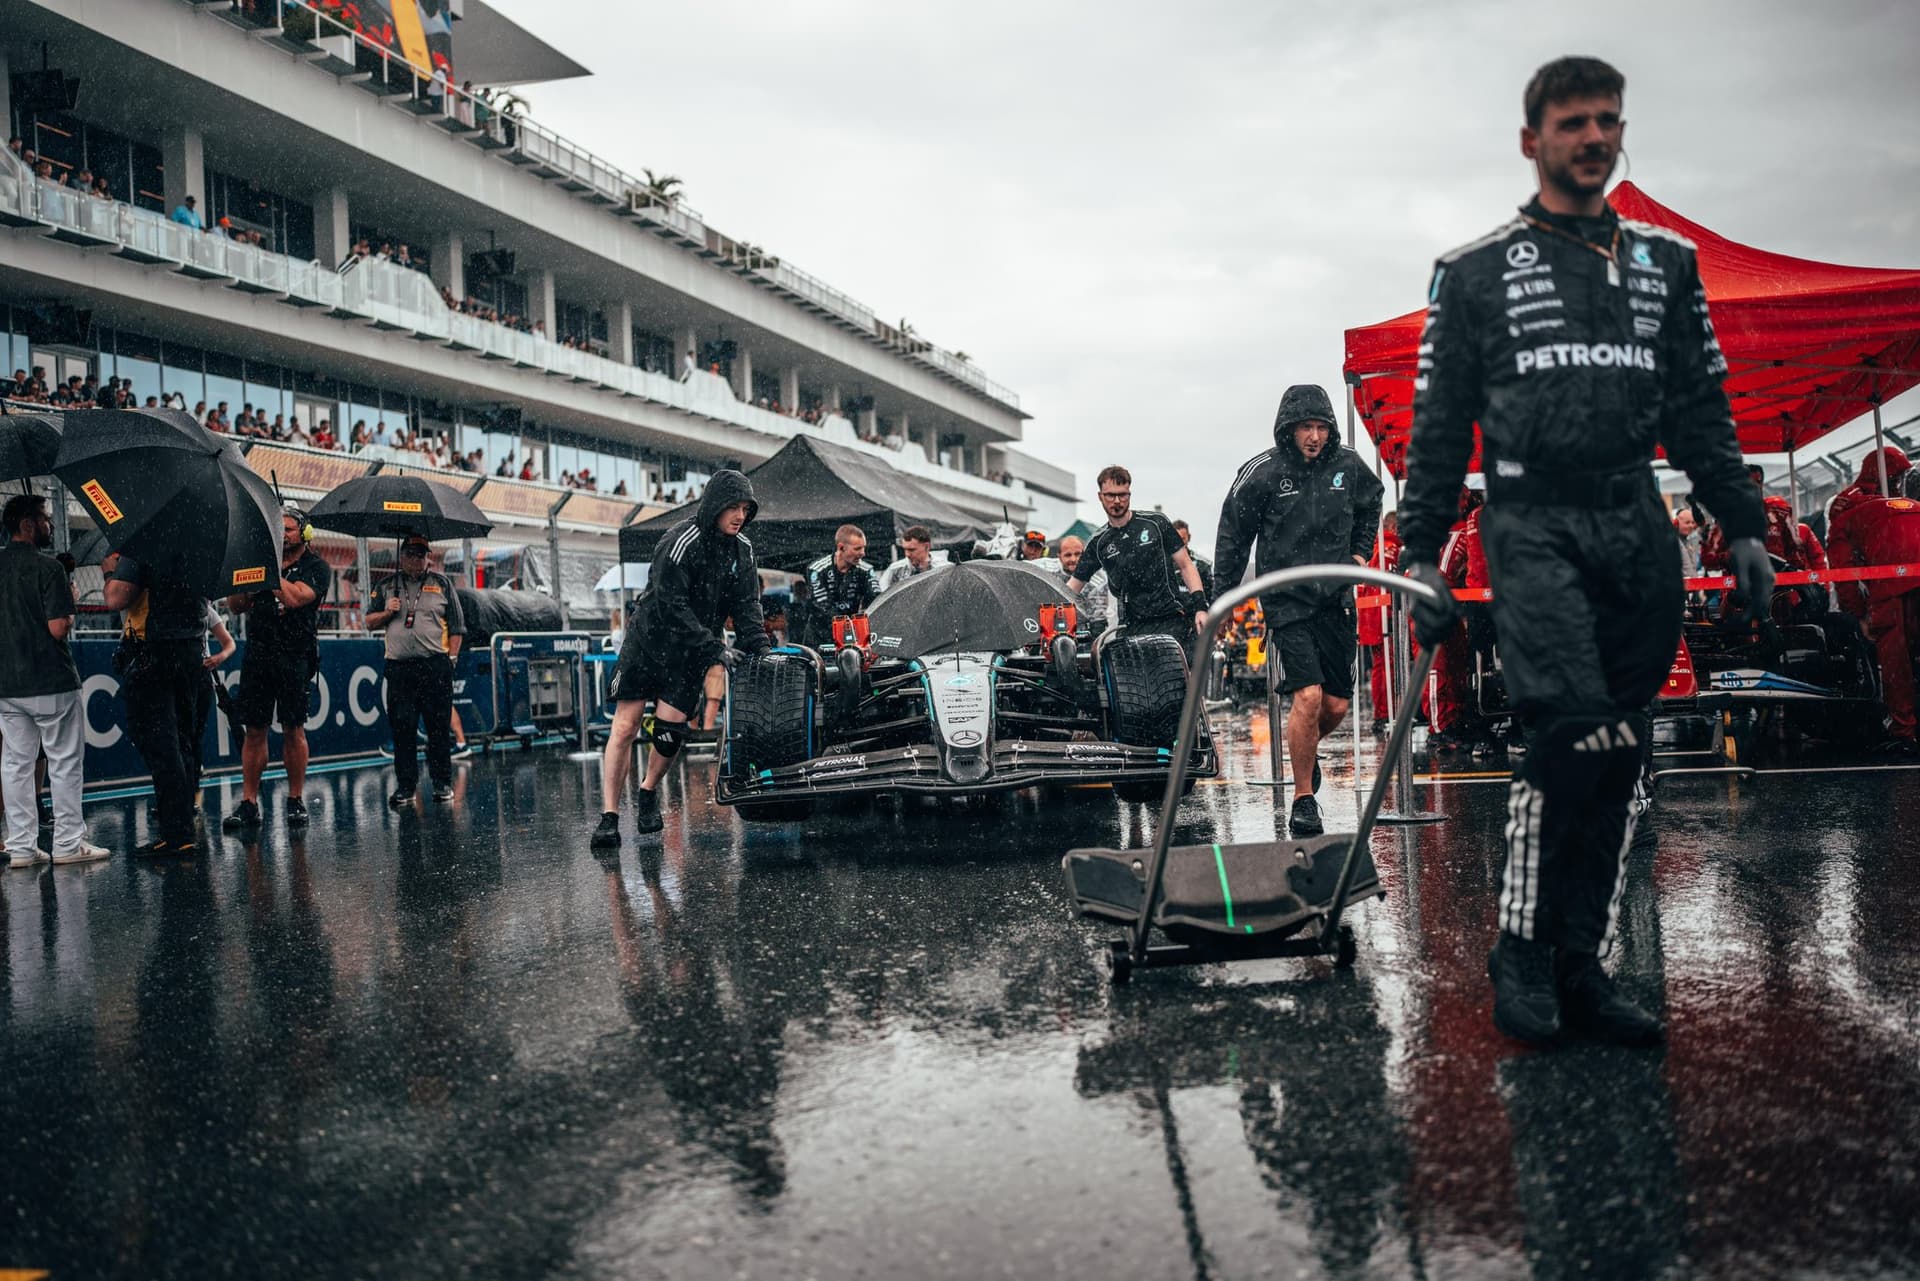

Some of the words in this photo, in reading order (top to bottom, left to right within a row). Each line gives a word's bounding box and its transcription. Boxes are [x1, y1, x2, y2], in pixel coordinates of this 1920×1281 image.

[1524, 278, 1556, 296] UBS
[1515, 342, 1656, 375] PETRONAS
[86, 484, 119, 520] PIRELLI
[235, 569, 263, 582] PIRELLI
[1066, 744, 1119, 753] PETRONAS
[813, 755, 867, 768] PETRONAS
